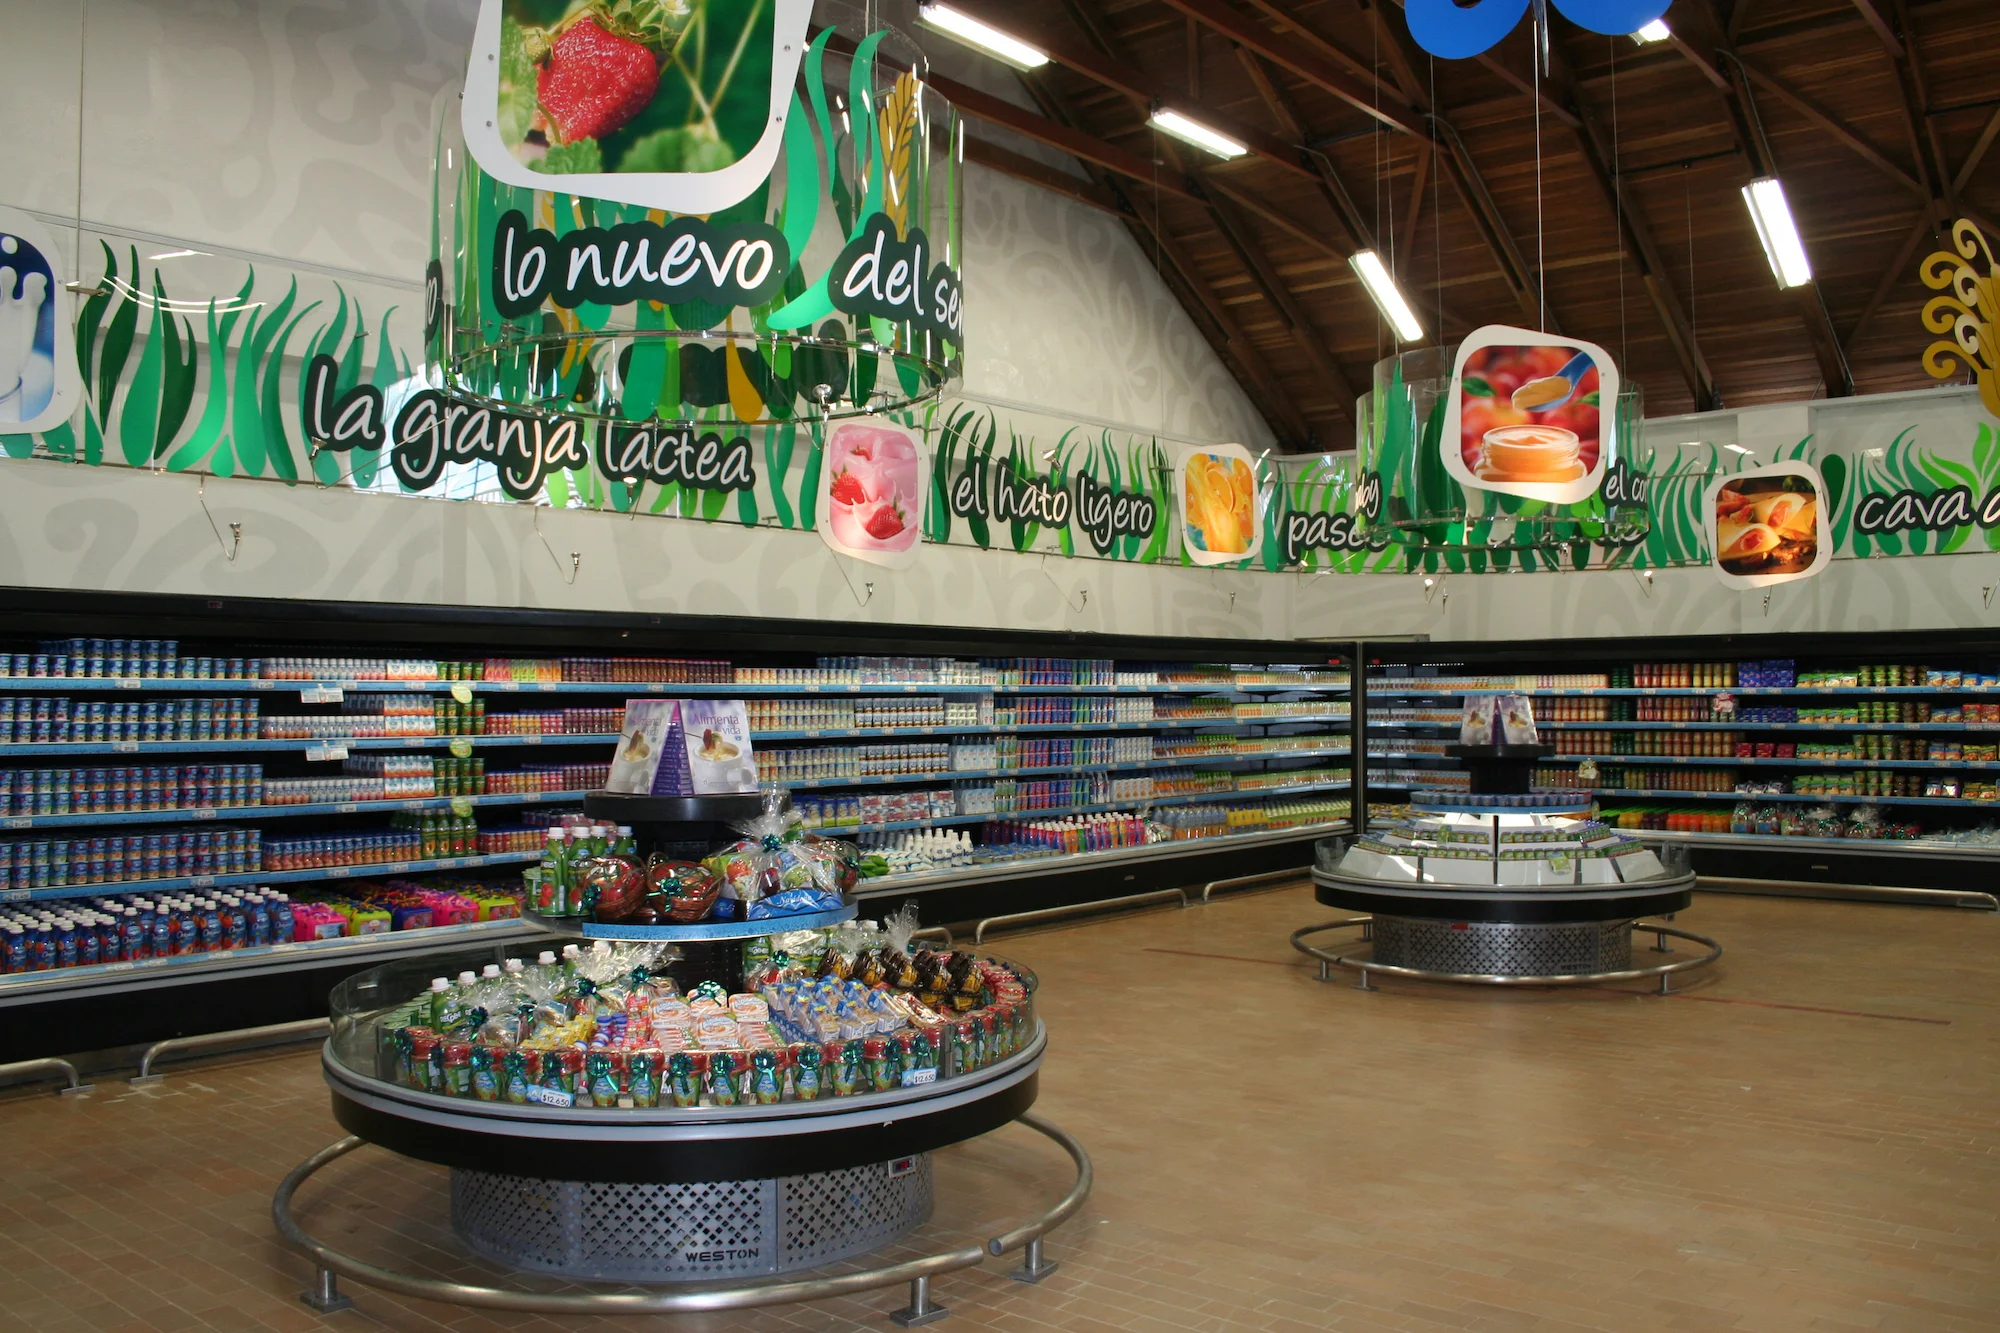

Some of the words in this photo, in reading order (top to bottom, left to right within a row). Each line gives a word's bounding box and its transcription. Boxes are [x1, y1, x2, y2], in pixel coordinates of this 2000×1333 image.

[503, 226, 547, 301] lo
[566, 232, 774, 292] nuevo
[843, 229, 925, 316] del
[934, 278, 963, 337] se
[314, 364, 377, 441] la
[401, 398, 580, 490] granja
[1605, 463, 1627, 501] el
[955, 462, 986, 516] el
[999, 465, 1067, 522] hato
[1080, 476, 1153, 548] ligero
[1860, 490, 1970, 529] cava
[692, 713, 740, 725] Alimenta
[722, 724, 741, 735] vida
[914, 1073, 935, 1084] $12.650
[542, 1094, 570, 1108] $12.650
[685, 1248, 759, 1263] WESTON
